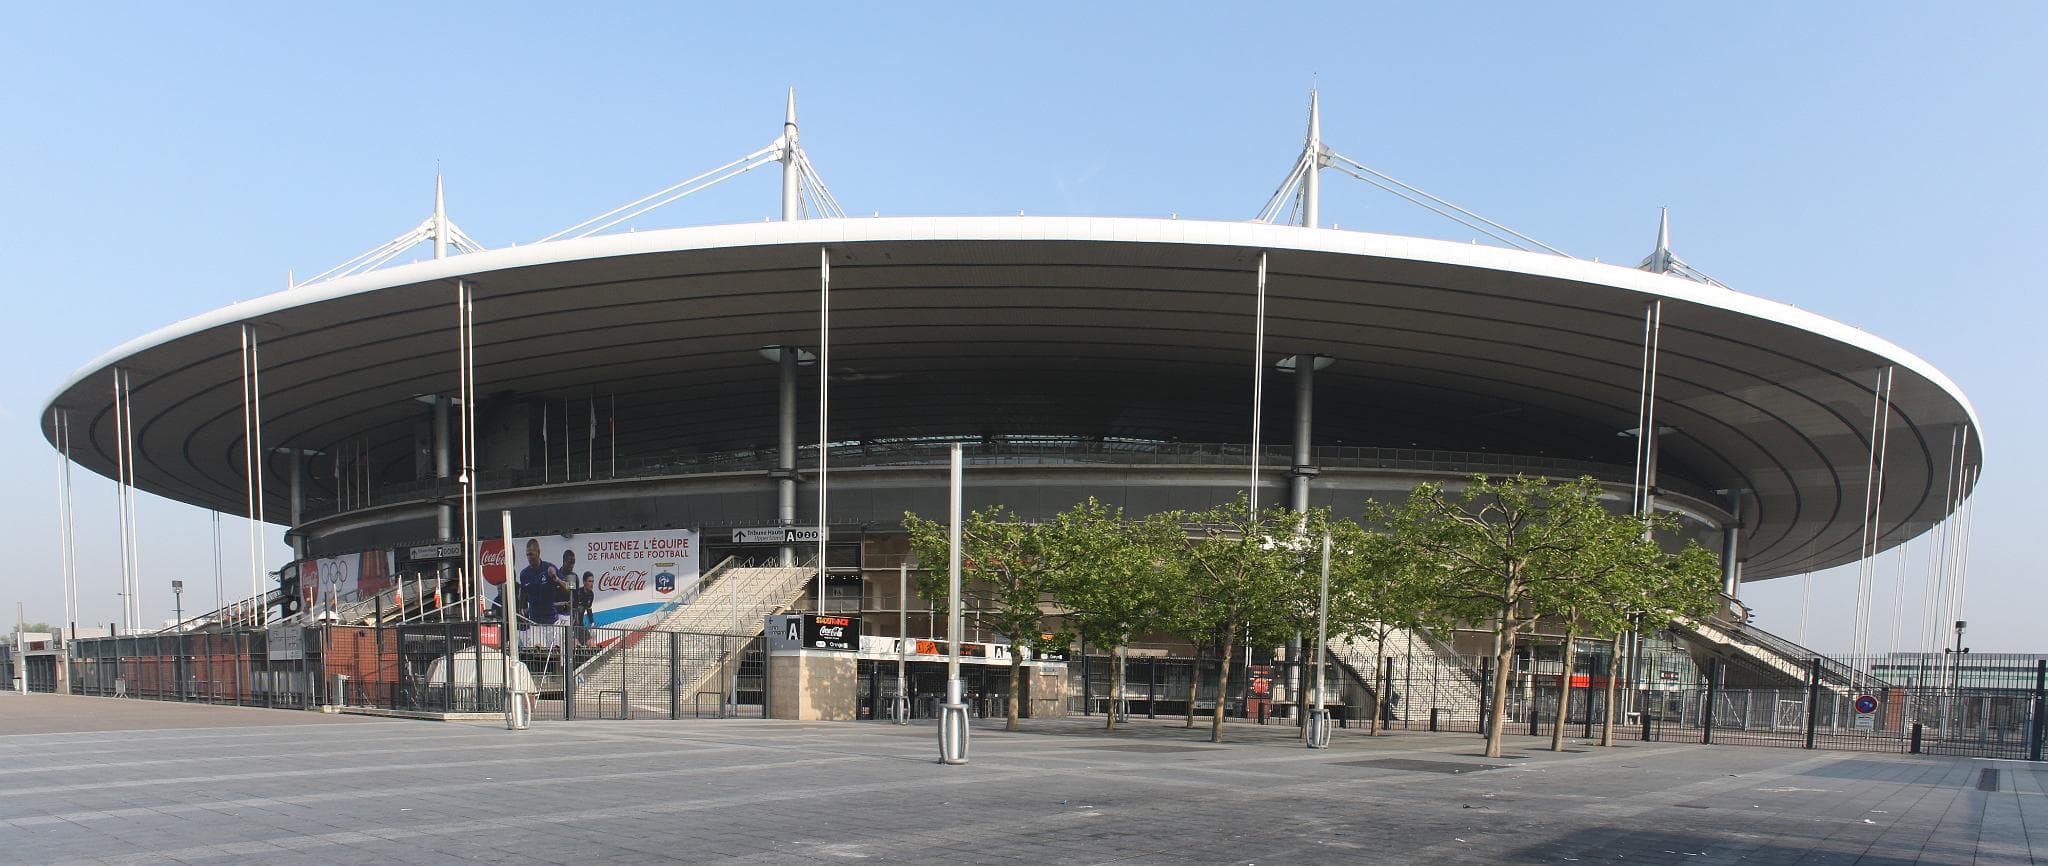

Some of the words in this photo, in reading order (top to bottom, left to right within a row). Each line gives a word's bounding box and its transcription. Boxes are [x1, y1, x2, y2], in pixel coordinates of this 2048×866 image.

[786, 531, 795, 542] A
[588, 540, 640, 552] SOUTENEZ
[643, 537, 689, 549] L'ÉQUIPE
[587, 552, 598, 561] DE
[600, 551, 631, 560] FRANCE
[633, 551, 644, 559] DE
[647, 549, 689, 559] FOOTBALL
[788, 623, 799, 641] A
